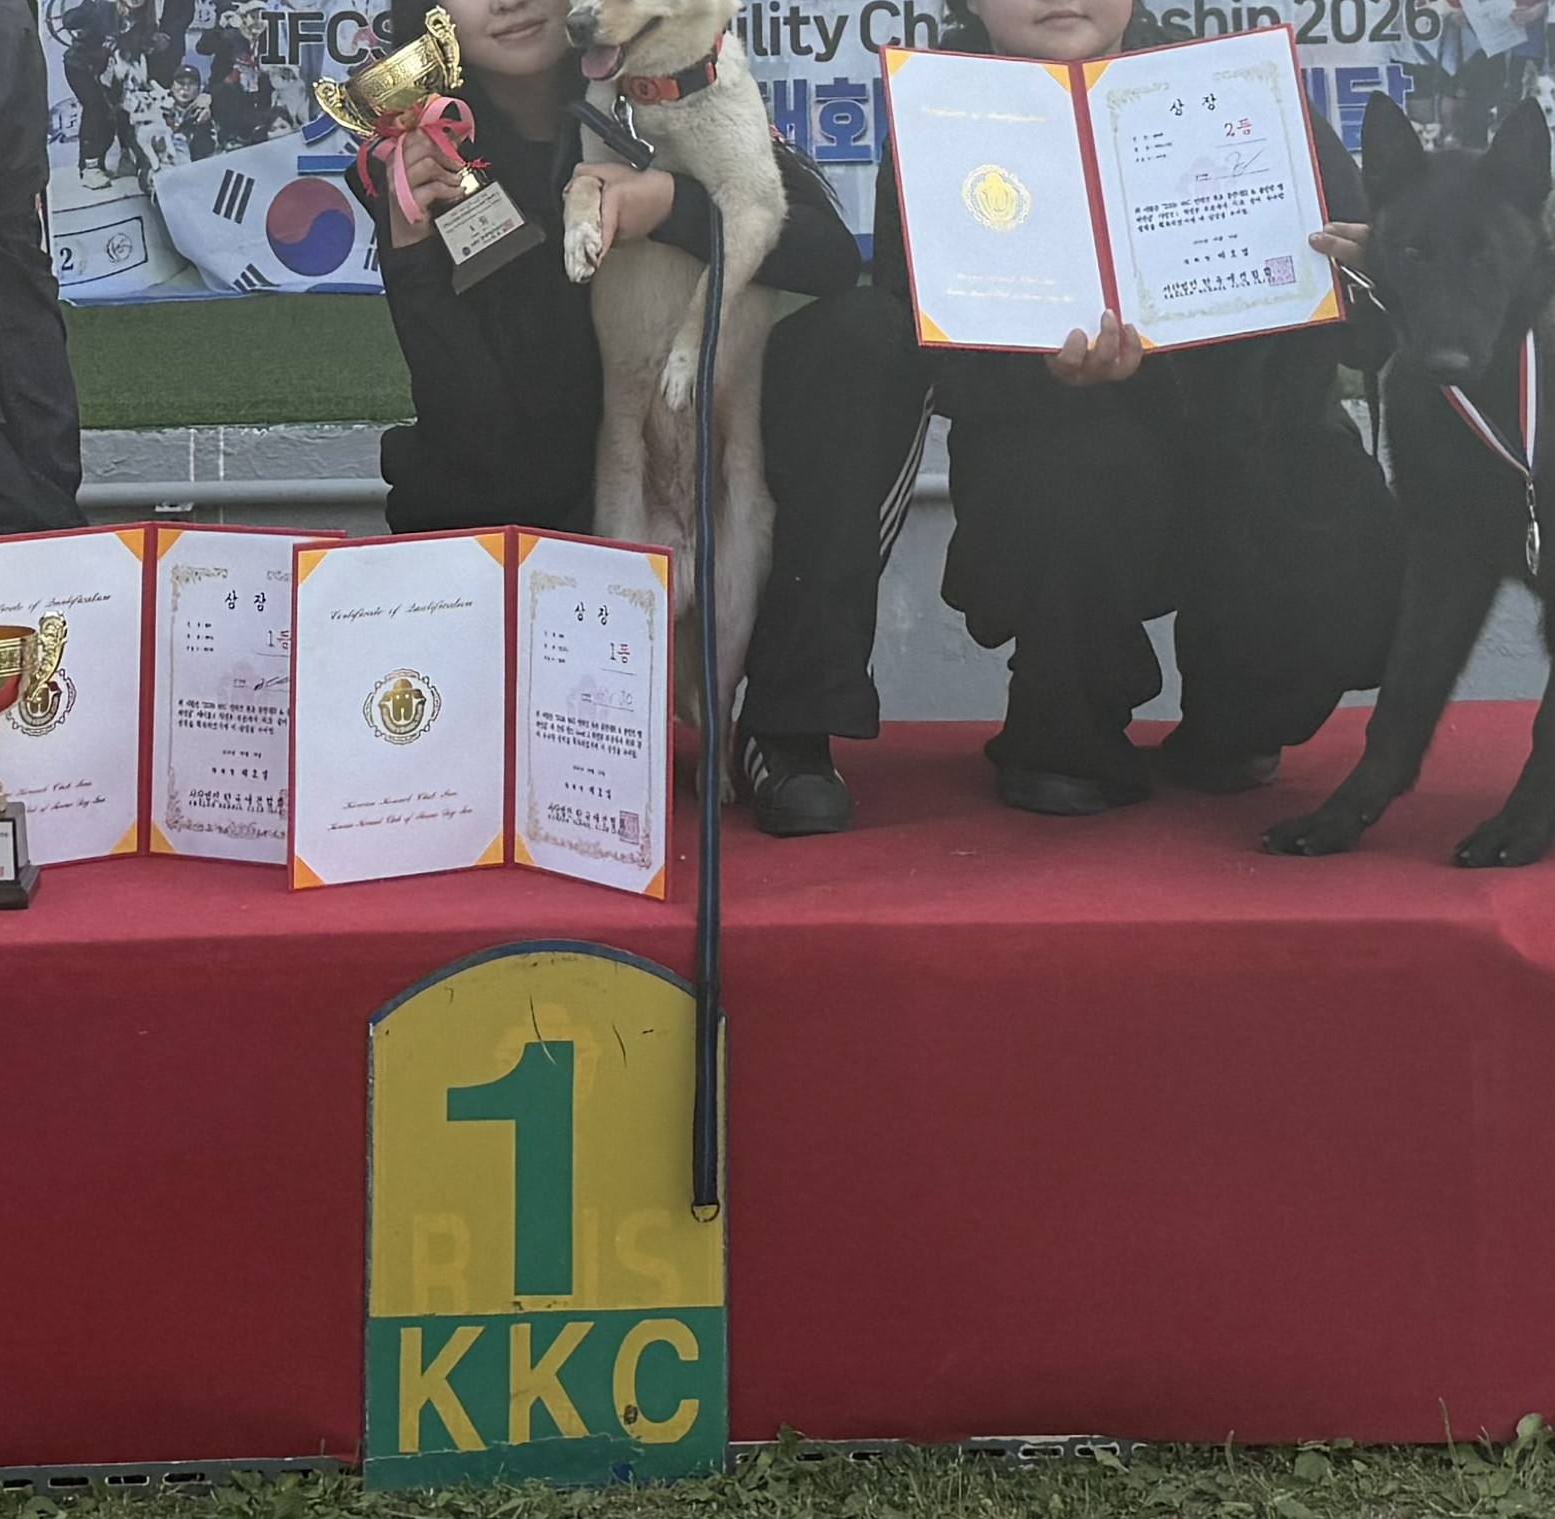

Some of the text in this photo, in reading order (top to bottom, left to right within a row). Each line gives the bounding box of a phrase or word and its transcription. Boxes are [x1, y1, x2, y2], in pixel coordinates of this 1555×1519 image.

[59, 247, 75, 271] 2
[446, 1040, 574, 1296] 1
[397, 1318, 700, 1454] KKC
